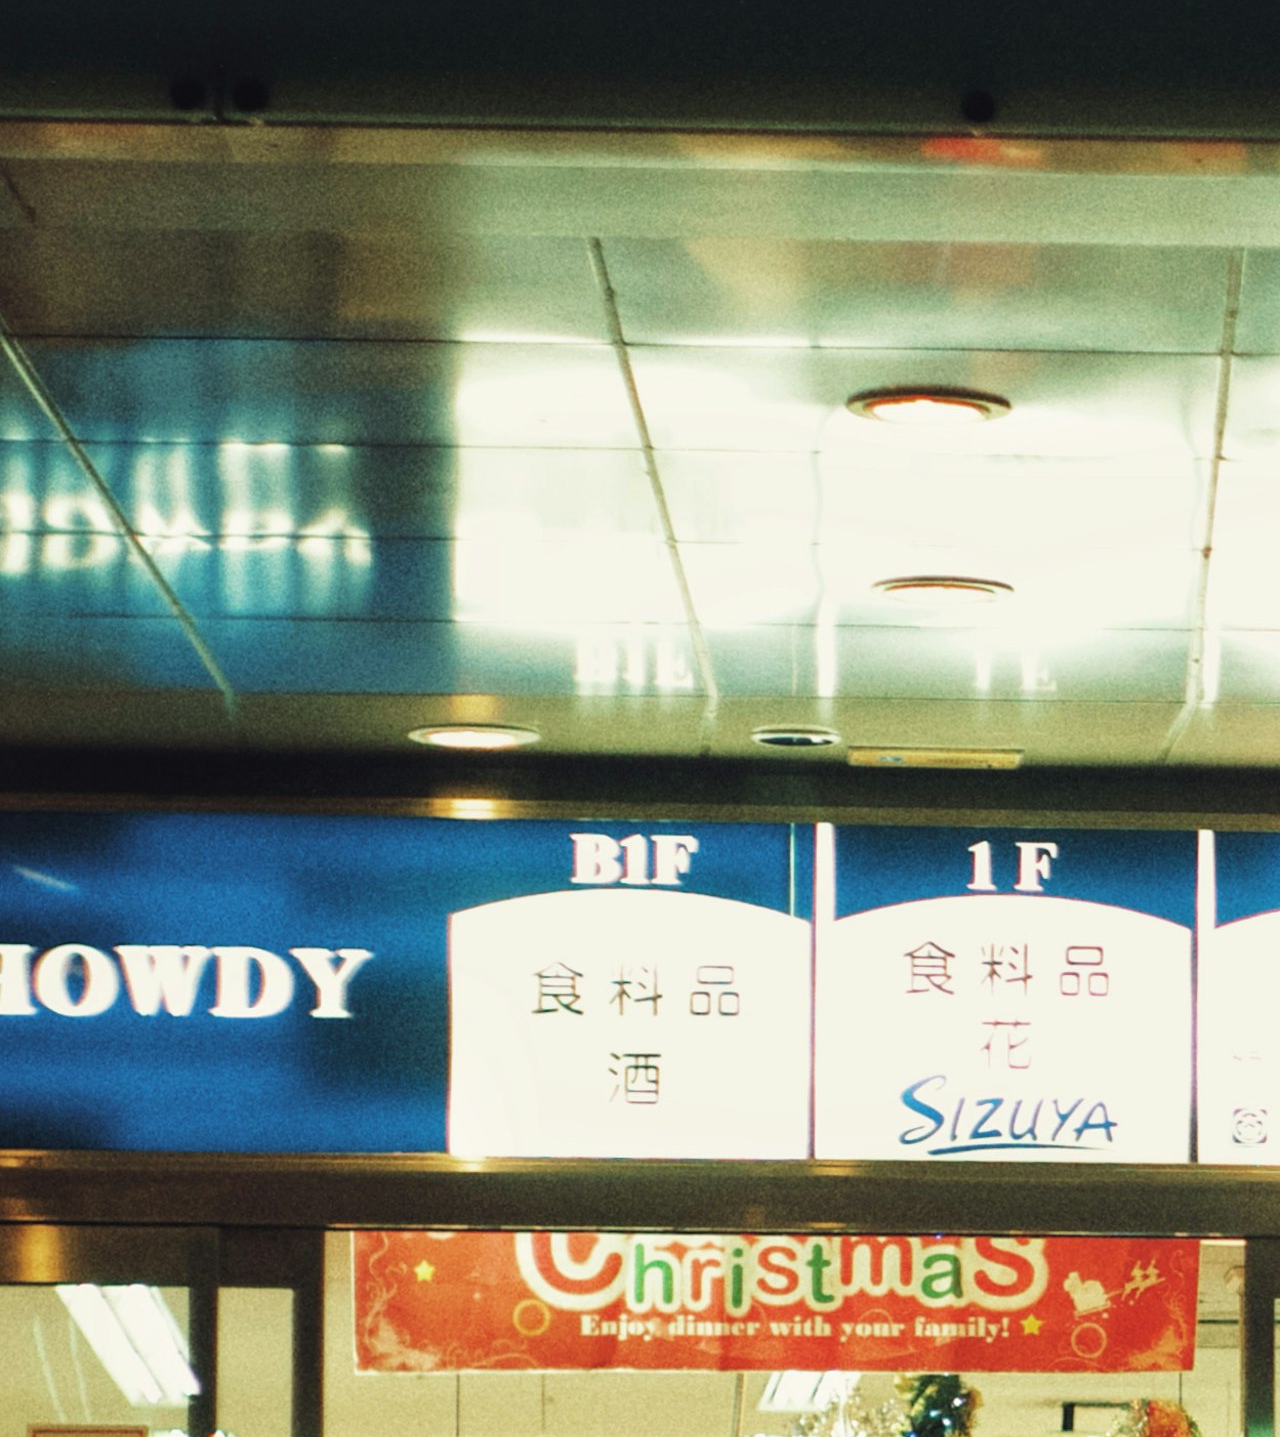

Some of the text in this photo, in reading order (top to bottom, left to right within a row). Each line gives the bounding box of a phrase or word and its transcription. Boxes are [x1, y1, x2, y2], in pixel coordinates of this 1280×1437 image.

[569, 831, 699, 887] B1F
[530, 961, 742, 1018] 食料品
[903, 940, 1112, 999] 食料品
[979, 1018, 1033, 1072] 花
[607, 1051, 662, 1105] 酒
[898, 1075, 1118, 1155] SIZUYA
[579, 1314, 1011, 1344] Enjoy dinner with your family!
